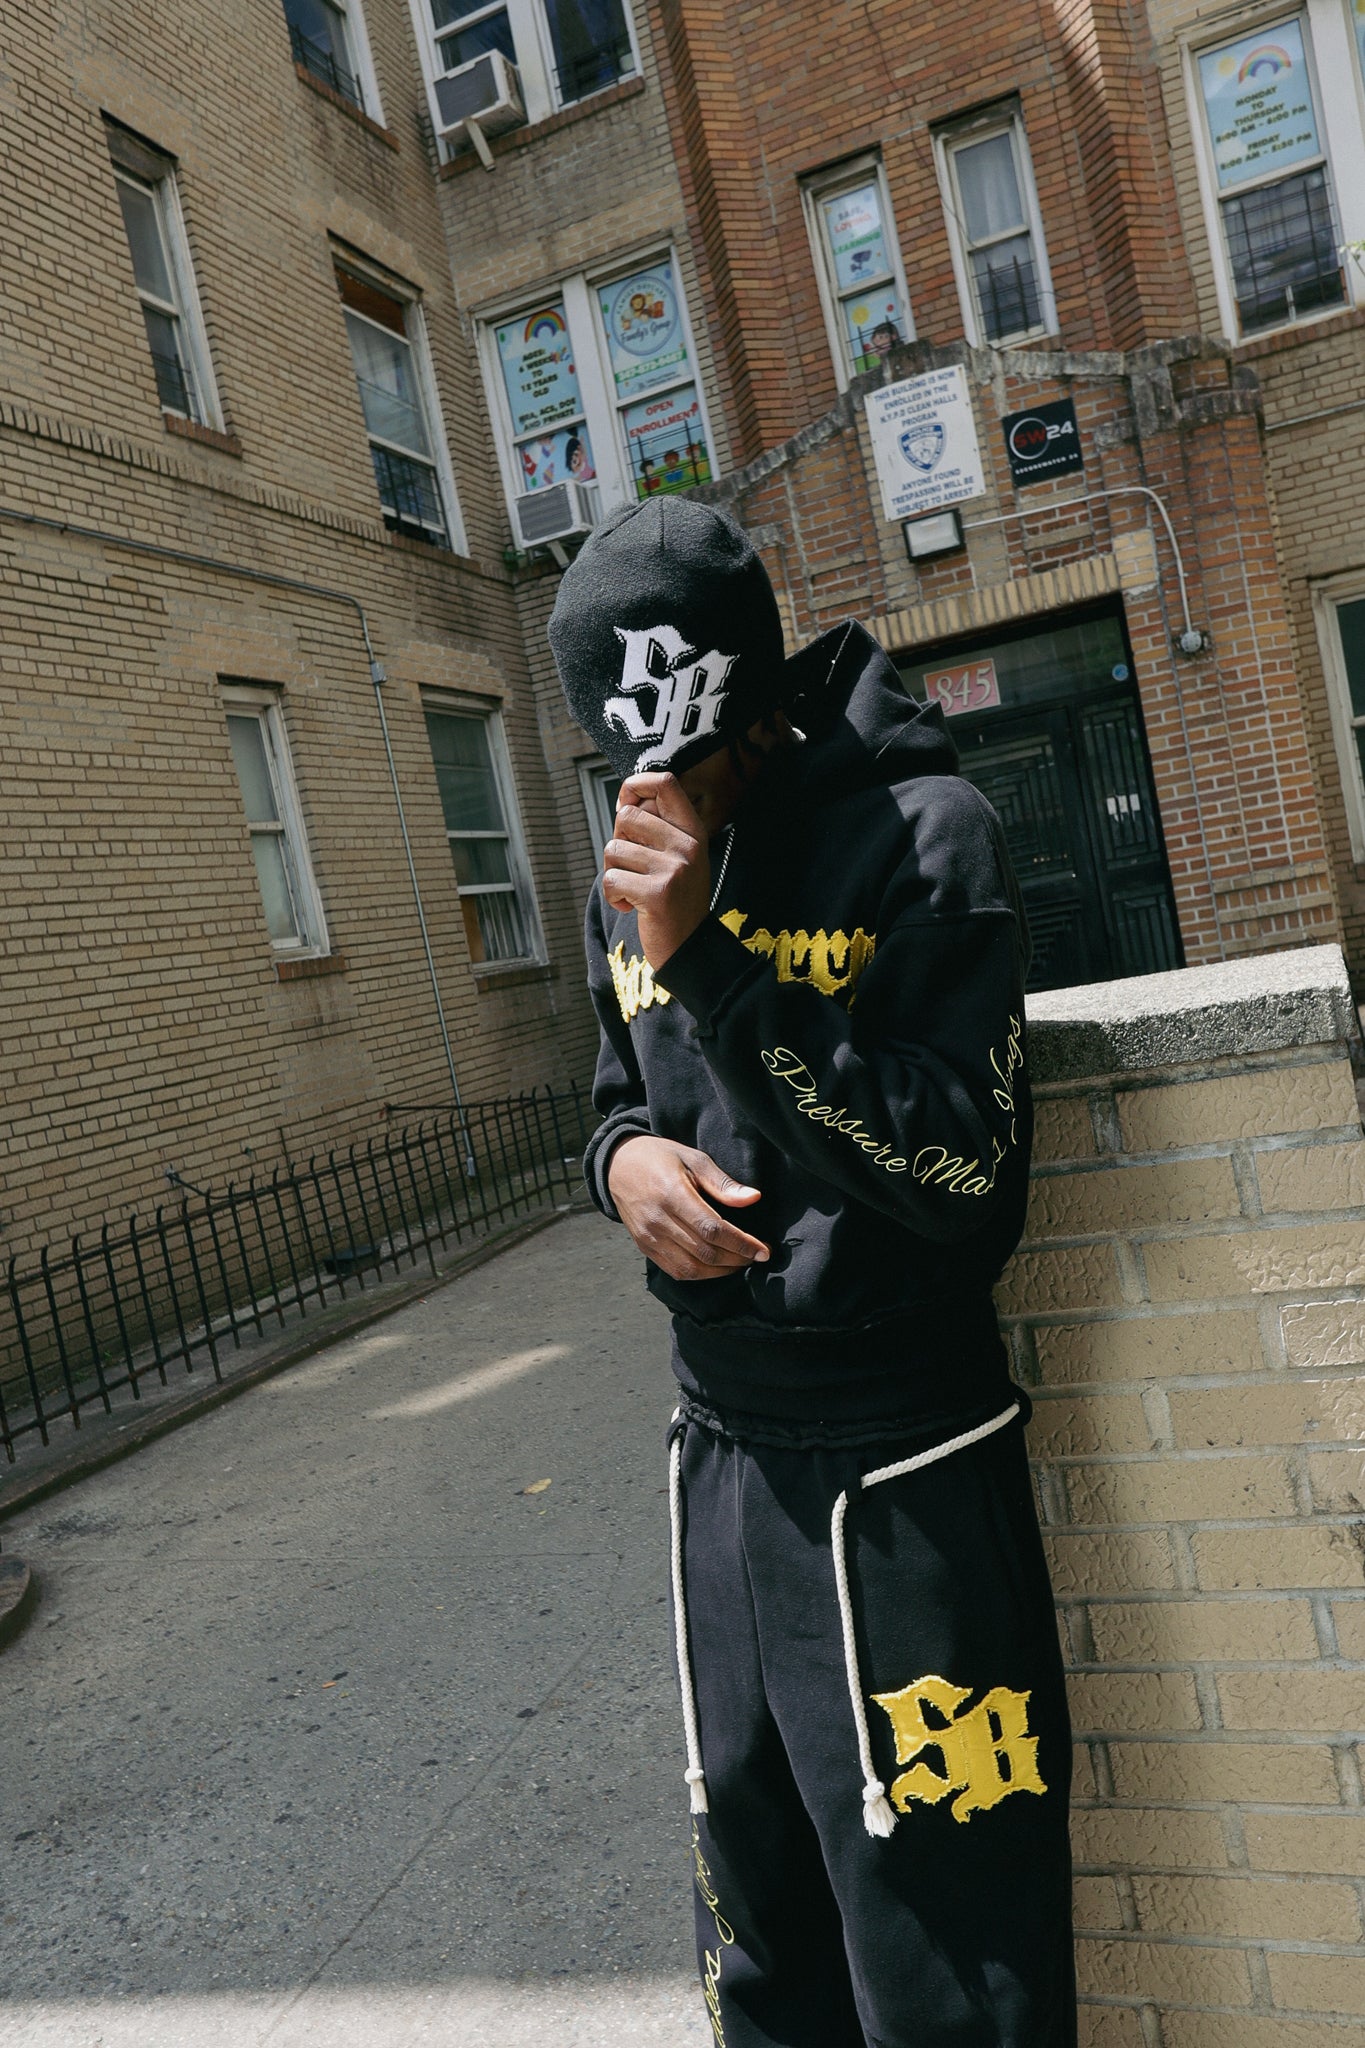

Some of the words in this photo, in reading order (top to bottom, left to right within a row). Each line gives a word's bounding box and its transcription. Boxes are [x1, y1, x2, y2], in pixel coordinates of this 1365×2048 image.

[1236, 86, 1277, 106] MONDAY
[1252, 101, 1263, 110] TO
[1234, 103, 1284, 126] THURSDAY
[1242, 124, 1255, 134] AM
[1293, 105, 1307, 116] PM
[1246, 151, 1259, 161] AM
[1297, 133, 1311, 143] PM
[1248, 134, 1280, 150] FRIDAY
[522, 348, 546, 362] AGES:
[532, 369, 543, 379] TO
[533, 374, 558, 388] YEARS
[532, 387, 549, 398] OLD
[874, 390, 890, 402] THIS
[892, 379, 927, 396] BUILDING
[928, 376, 937, 386] IS
[937, 370, 956, 383] NOW
[884, 392, 922, 411] ENROLLED
[924, 389, 932, 399] IN
[934, 384, 949, 394] THE
[645, 400, 674, 416] OPEN
[907, 401, 932, 415] CLEAN
[934, 393, 958, 407] HALLS
[629, 408, 697, 438] ENROLLMENT
[891, 484, 942, 505] TRESPASSING
[944, 478, 962, 490] WILL
[963, 475, 974, 484] BE
[902, 476, 933, 491] ANYONE
[934, 468, 962, 482] FOUND
[896, 499, 929, 515] SUBJECT
[931, 494, 942, 504] TO
[944, 486, 974, 501] ARREST
[936, 666, 992, 712] 845
[760, 1046, 907, 1173] Pressure
